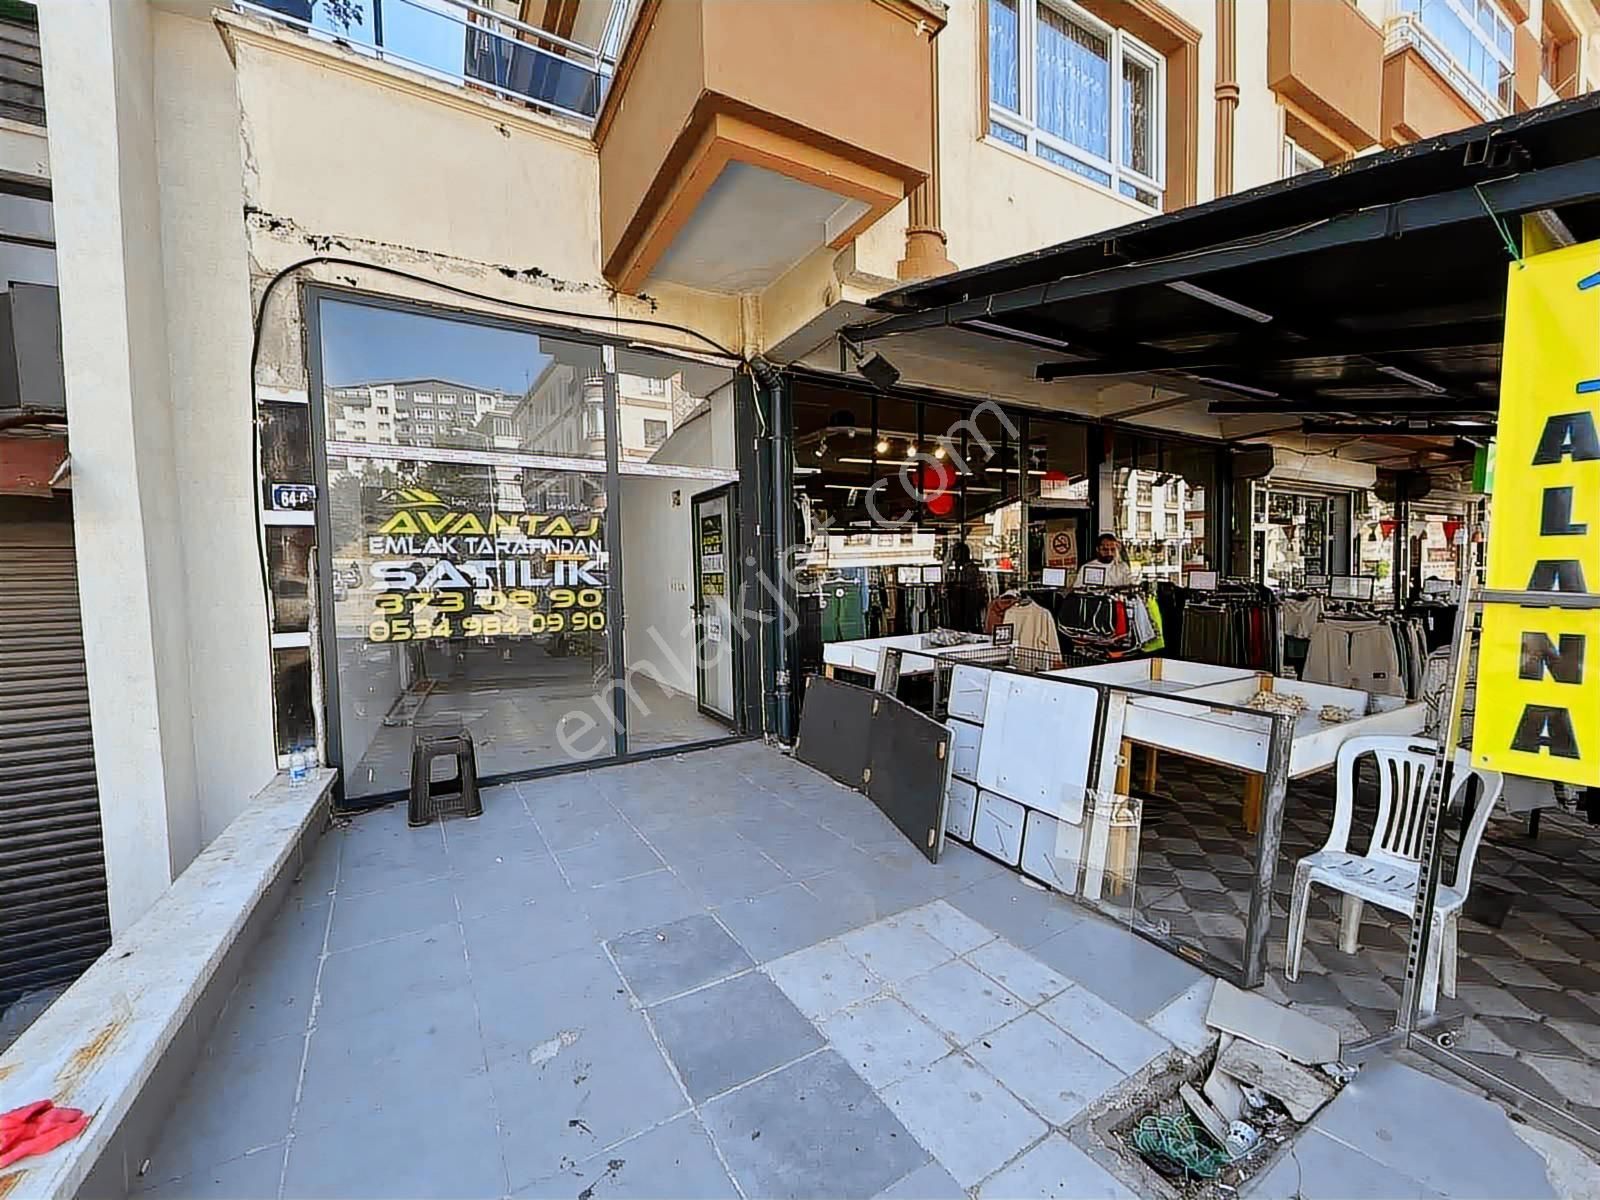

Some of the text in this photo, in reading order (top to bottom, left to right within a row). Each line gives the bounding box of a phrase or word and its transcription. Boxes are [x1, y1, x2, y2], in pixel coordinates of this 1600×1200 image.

[377, 511, 601, 537] AVANTAJ
[368, 537, 602, 555] EMLAK TARAFINDAN
[369, 559, 603, 590] SATILIK
[1509, 411, 1600, 760] ALANA
[372, 591, 465, 616] 373
[548, 587, 603, 609] 90
[368, 610, 605, 643] 0534 984 09 90
